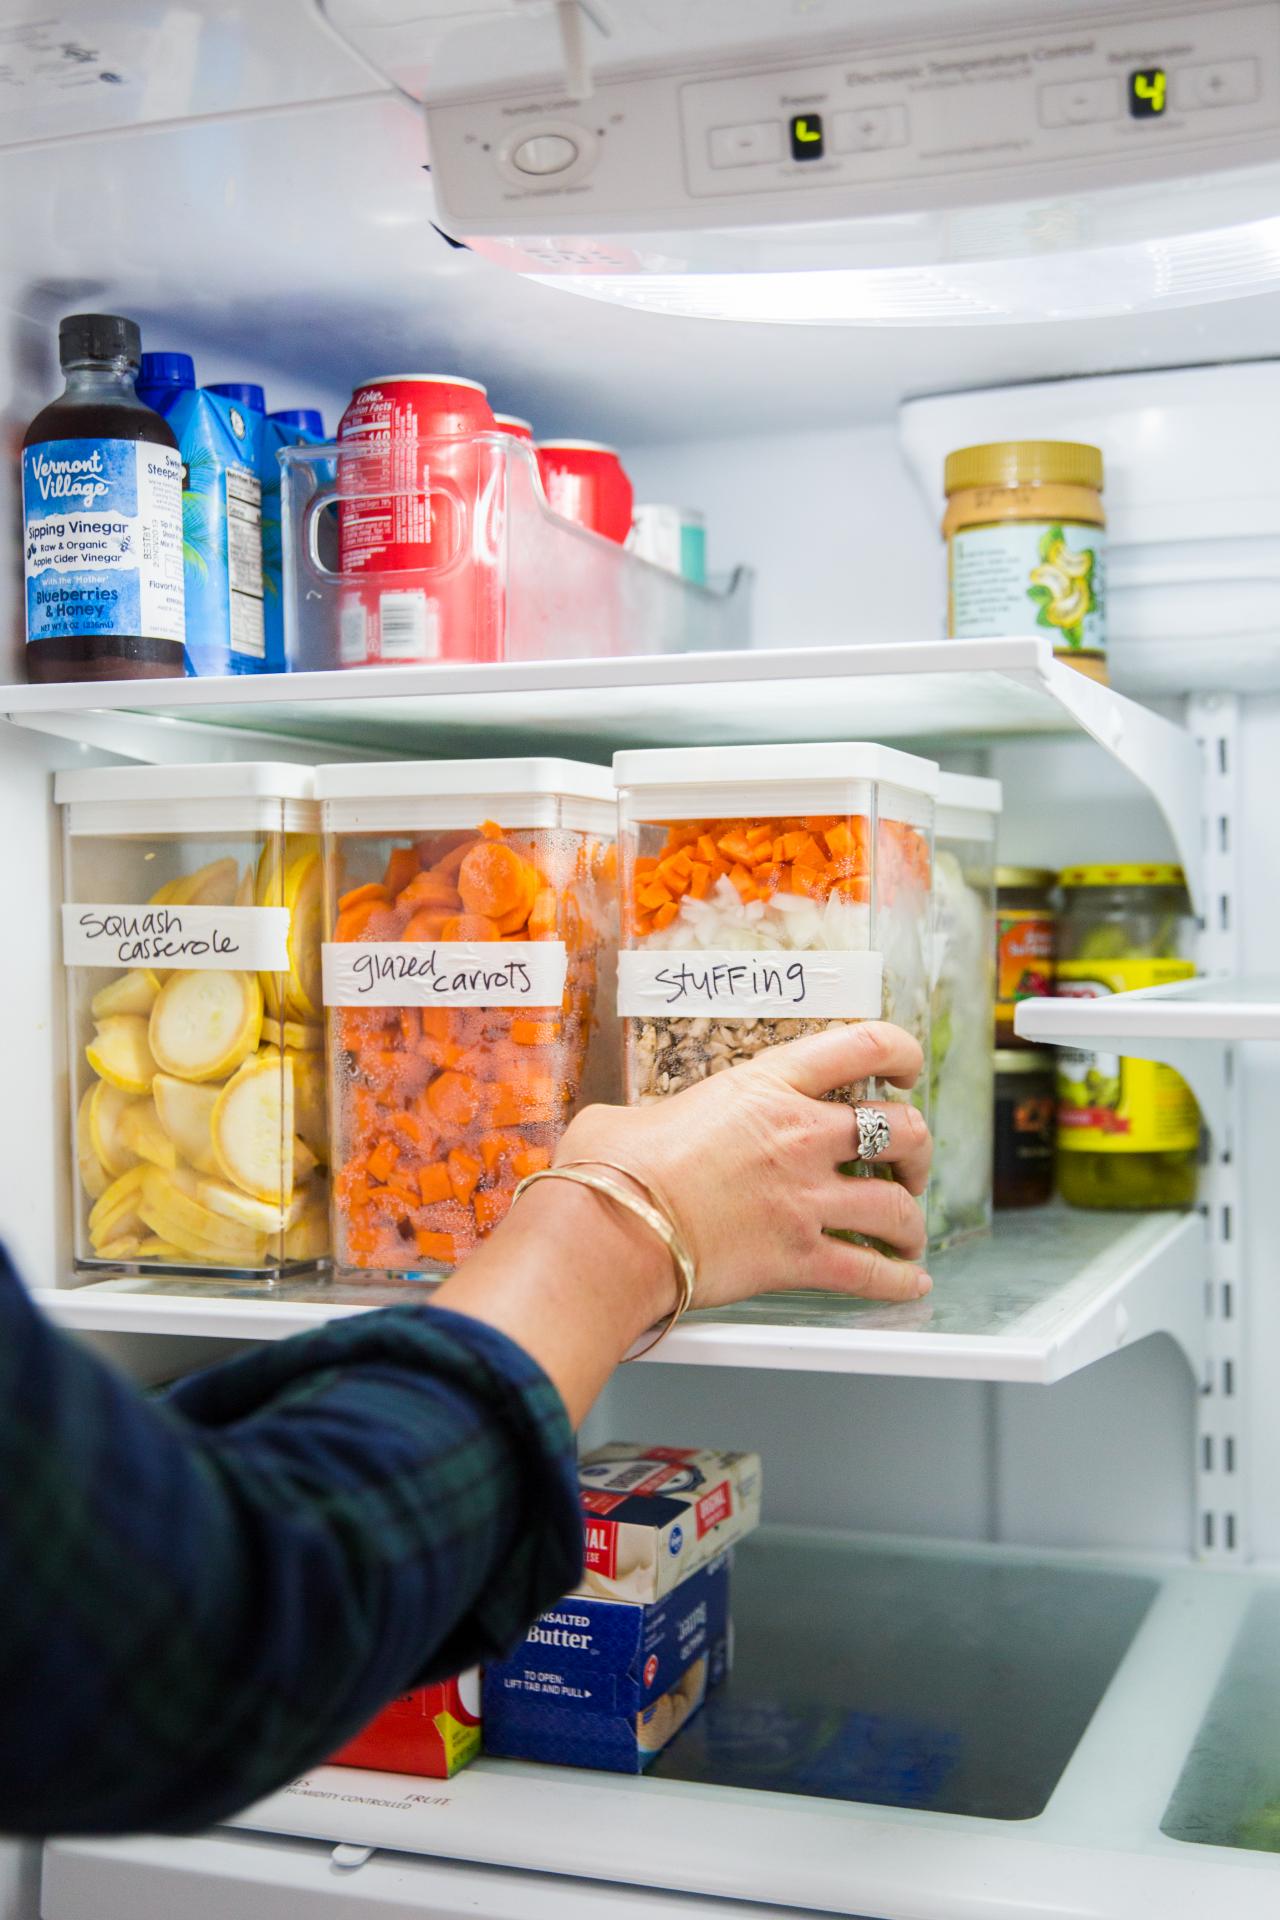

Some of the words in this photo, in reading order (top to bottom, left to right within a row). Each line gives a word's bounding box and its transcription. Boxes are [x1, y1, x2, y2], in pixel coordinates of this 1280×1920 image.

[1134, 71, 1166, 112] 4
[32, 449, 103, 480] Vermont
[40, 474, 109, 508] Village
[28, 523, 65, 541] Sipping
[69, 521, 129, 536] Vinegar
[41, 544, 56, 553] Raw
[58, 542, 65, 551] &
[67, 540, 108, 552] Organic
[34, 556, 52, 567] Apple
[54, 554, 78, 564] Cider
[81, 553, 122, 564] Vinegar
[36, 586, 119, 605] Blueberries
[45, 604, 54, 618] &
[56, 602, 105, 619] Honey
[118, 929, 239, 962] casserole
[352, 950, 437, 993] glazed
[432, 961, 531, 993] carrots
[525, 1625, 593, 1649] Butter
[523, 1670, 537, 1681] TO
[537, 1672, 565, 1684] OPEN:
[503, 1679, 522, 1689] LIFT
[523, 1681, 541, 1692] TAB
[541, 1683, 561, 1695] AND
[561, 1686, 584, 1698] PULL
[340, 1794, 412, 1810] CONTROLLED
